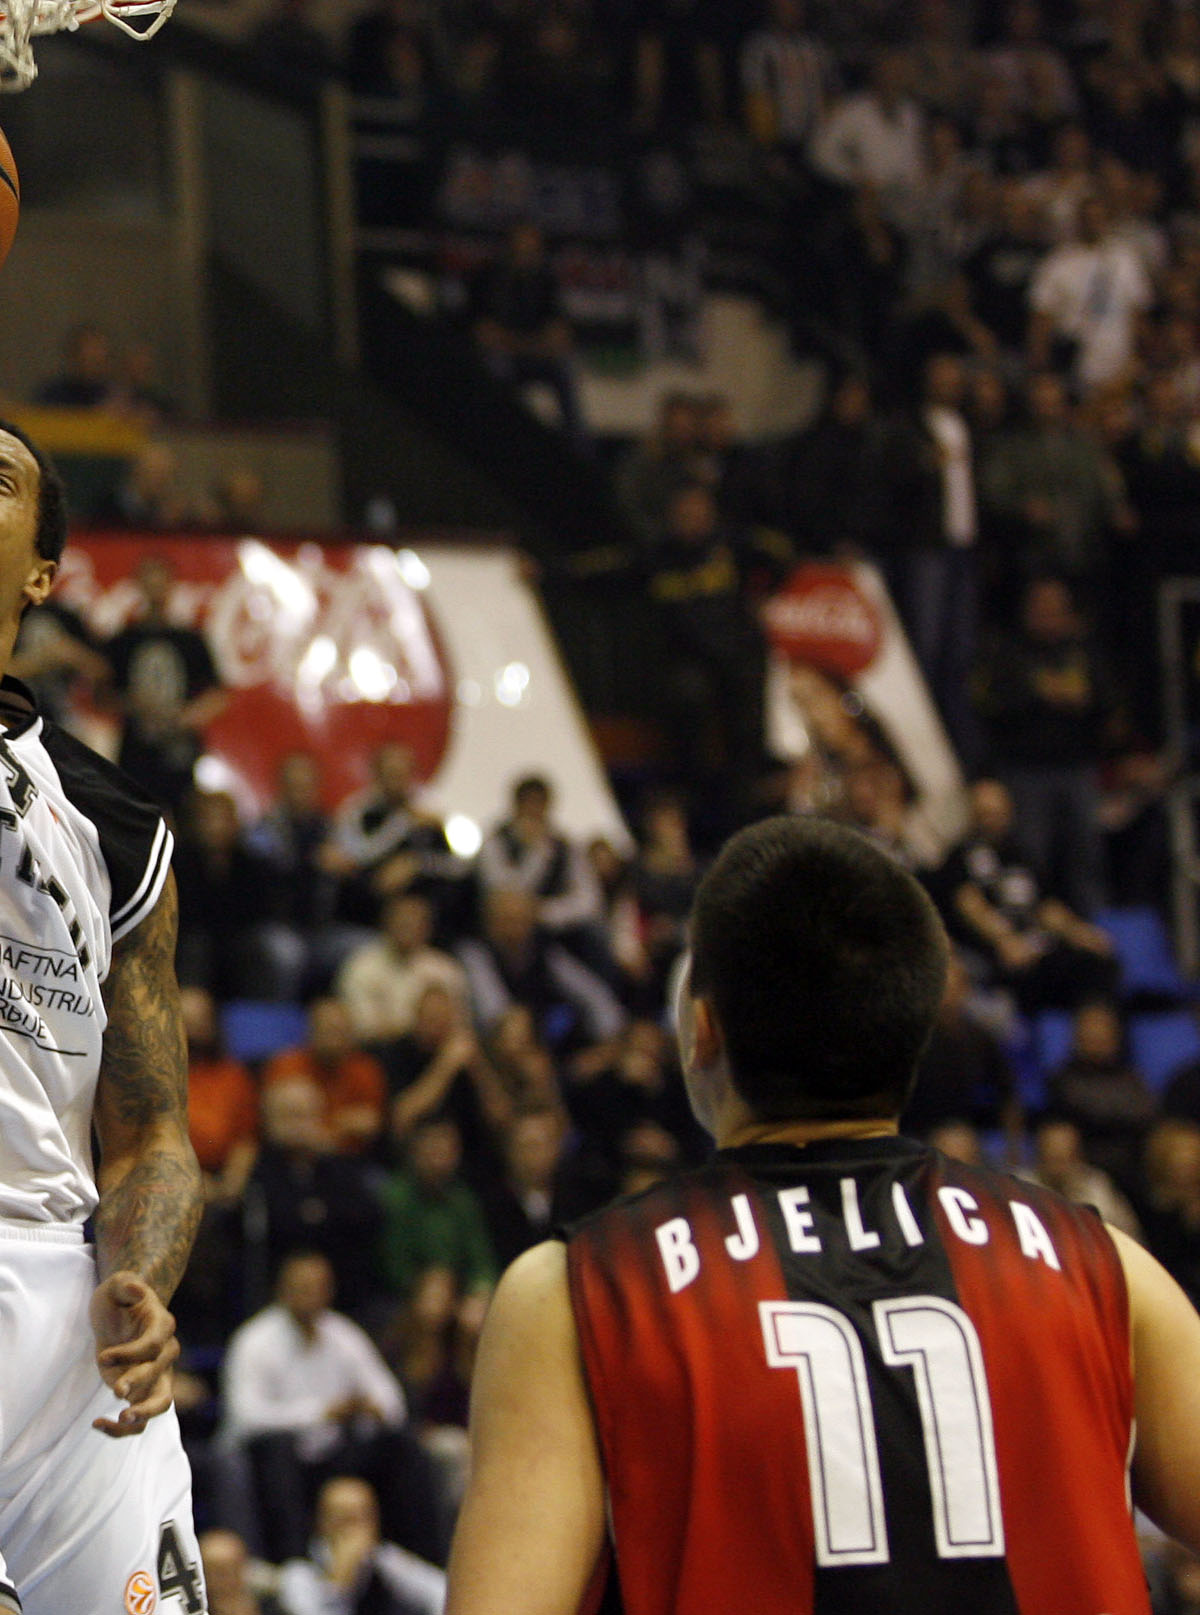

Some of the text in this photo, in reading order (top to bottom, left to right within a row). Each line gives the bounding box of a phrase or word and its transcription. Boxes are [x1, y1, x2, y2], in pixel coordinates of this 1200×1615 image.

[655, 1177, 1061, 1294] BJELICA
[758, 1295, 1006, 1567] 11
[157, 1519, 202, 1615] 4
